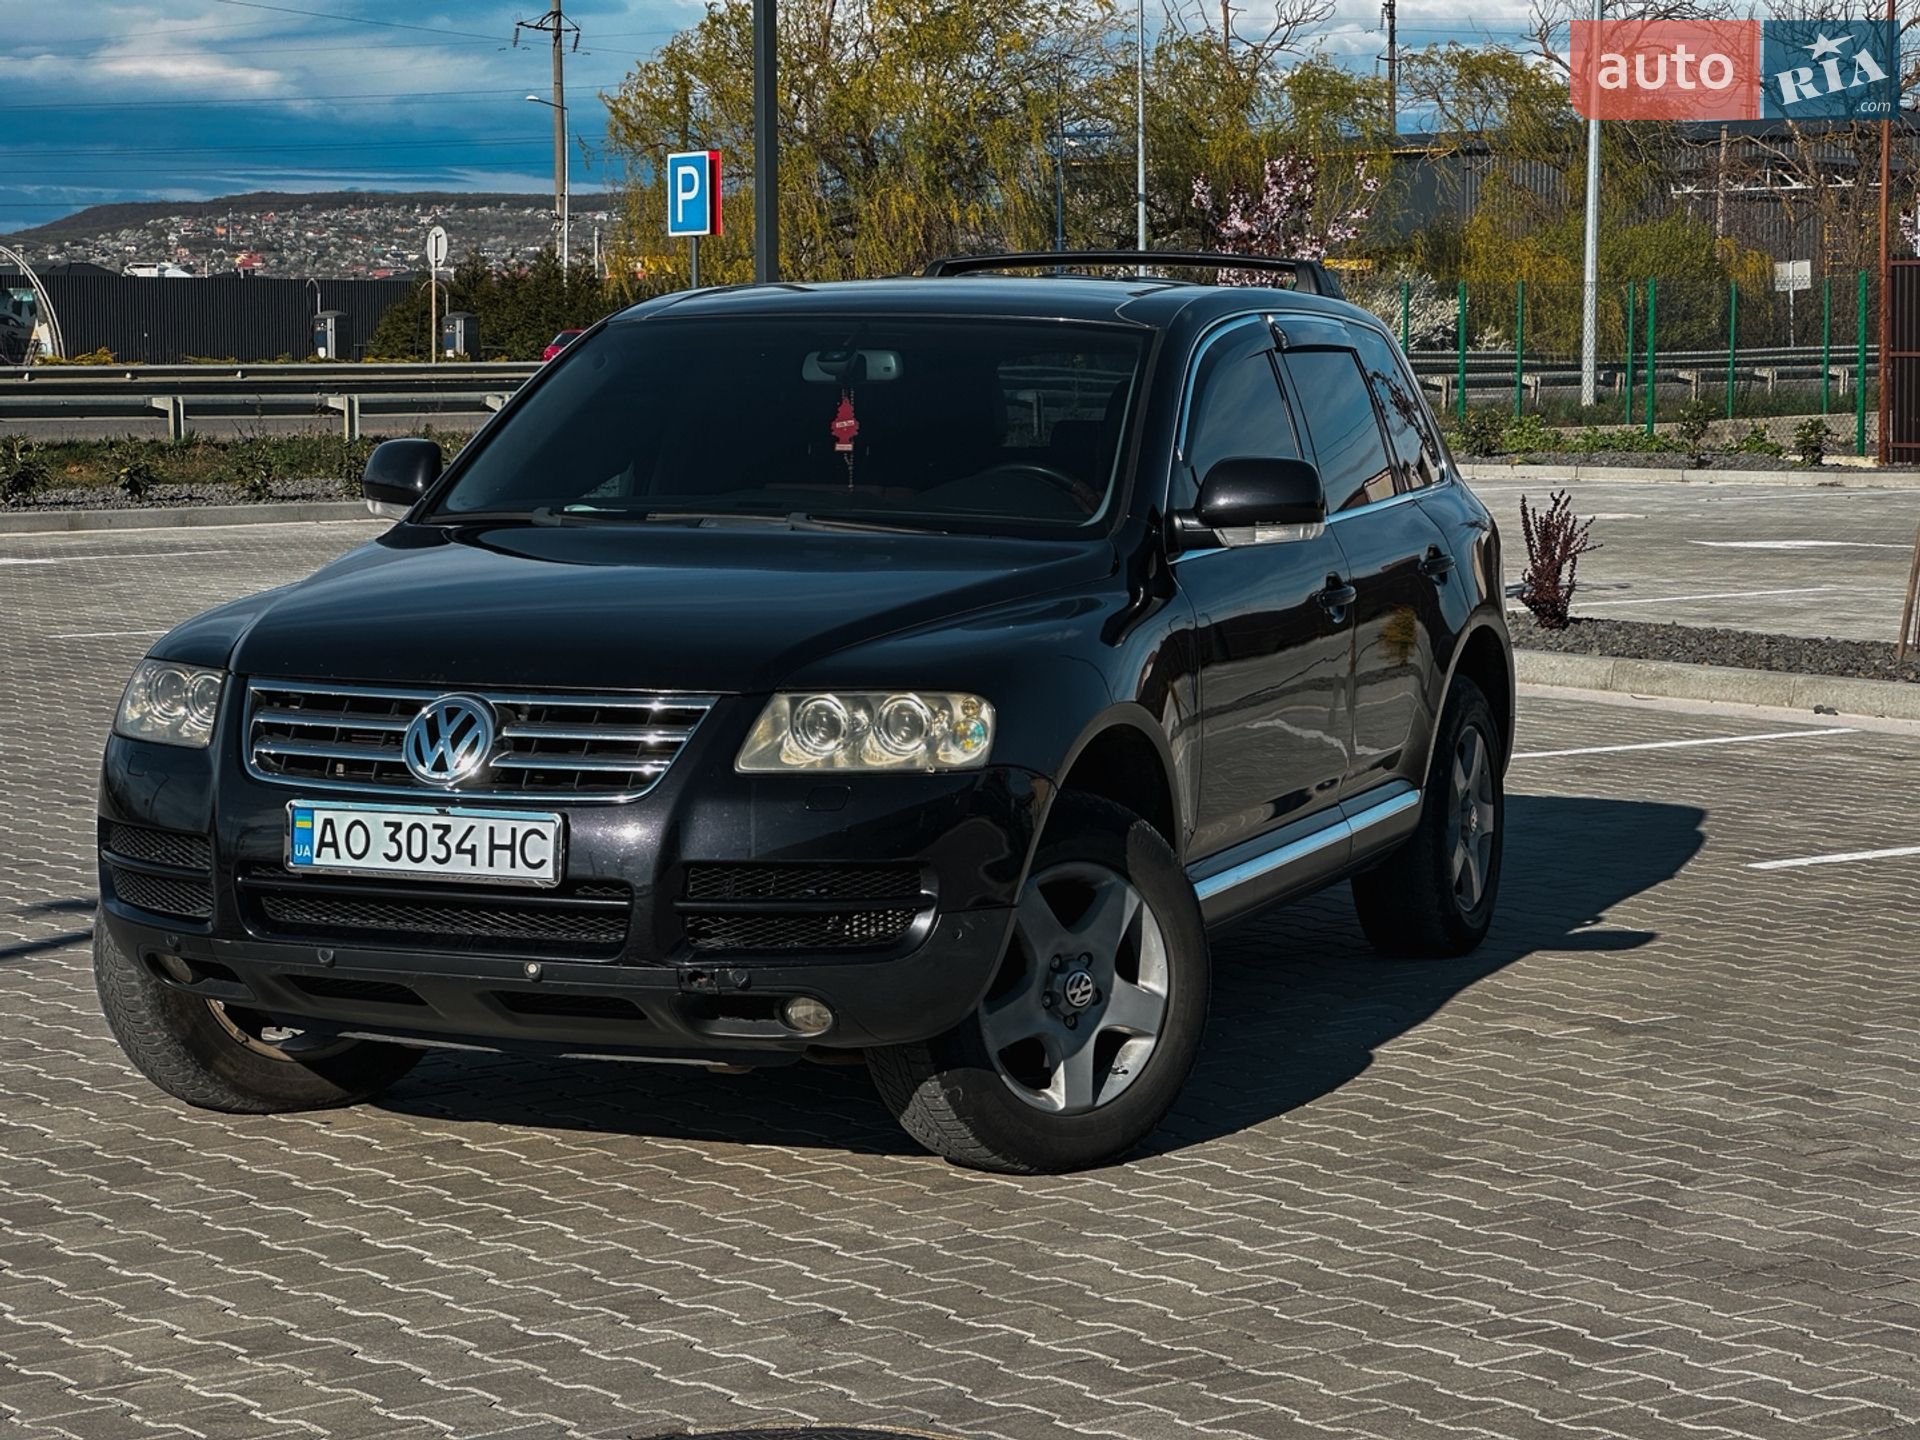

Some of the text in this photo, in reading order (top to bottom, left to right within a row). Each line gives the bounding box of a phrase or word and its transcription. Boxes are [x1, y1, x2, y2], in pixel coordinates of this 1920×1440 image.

[677, 165, 699, 223] P
[295, 843, 311, 858] UA
[315, 817, 548, 870] AO 3034 HC
